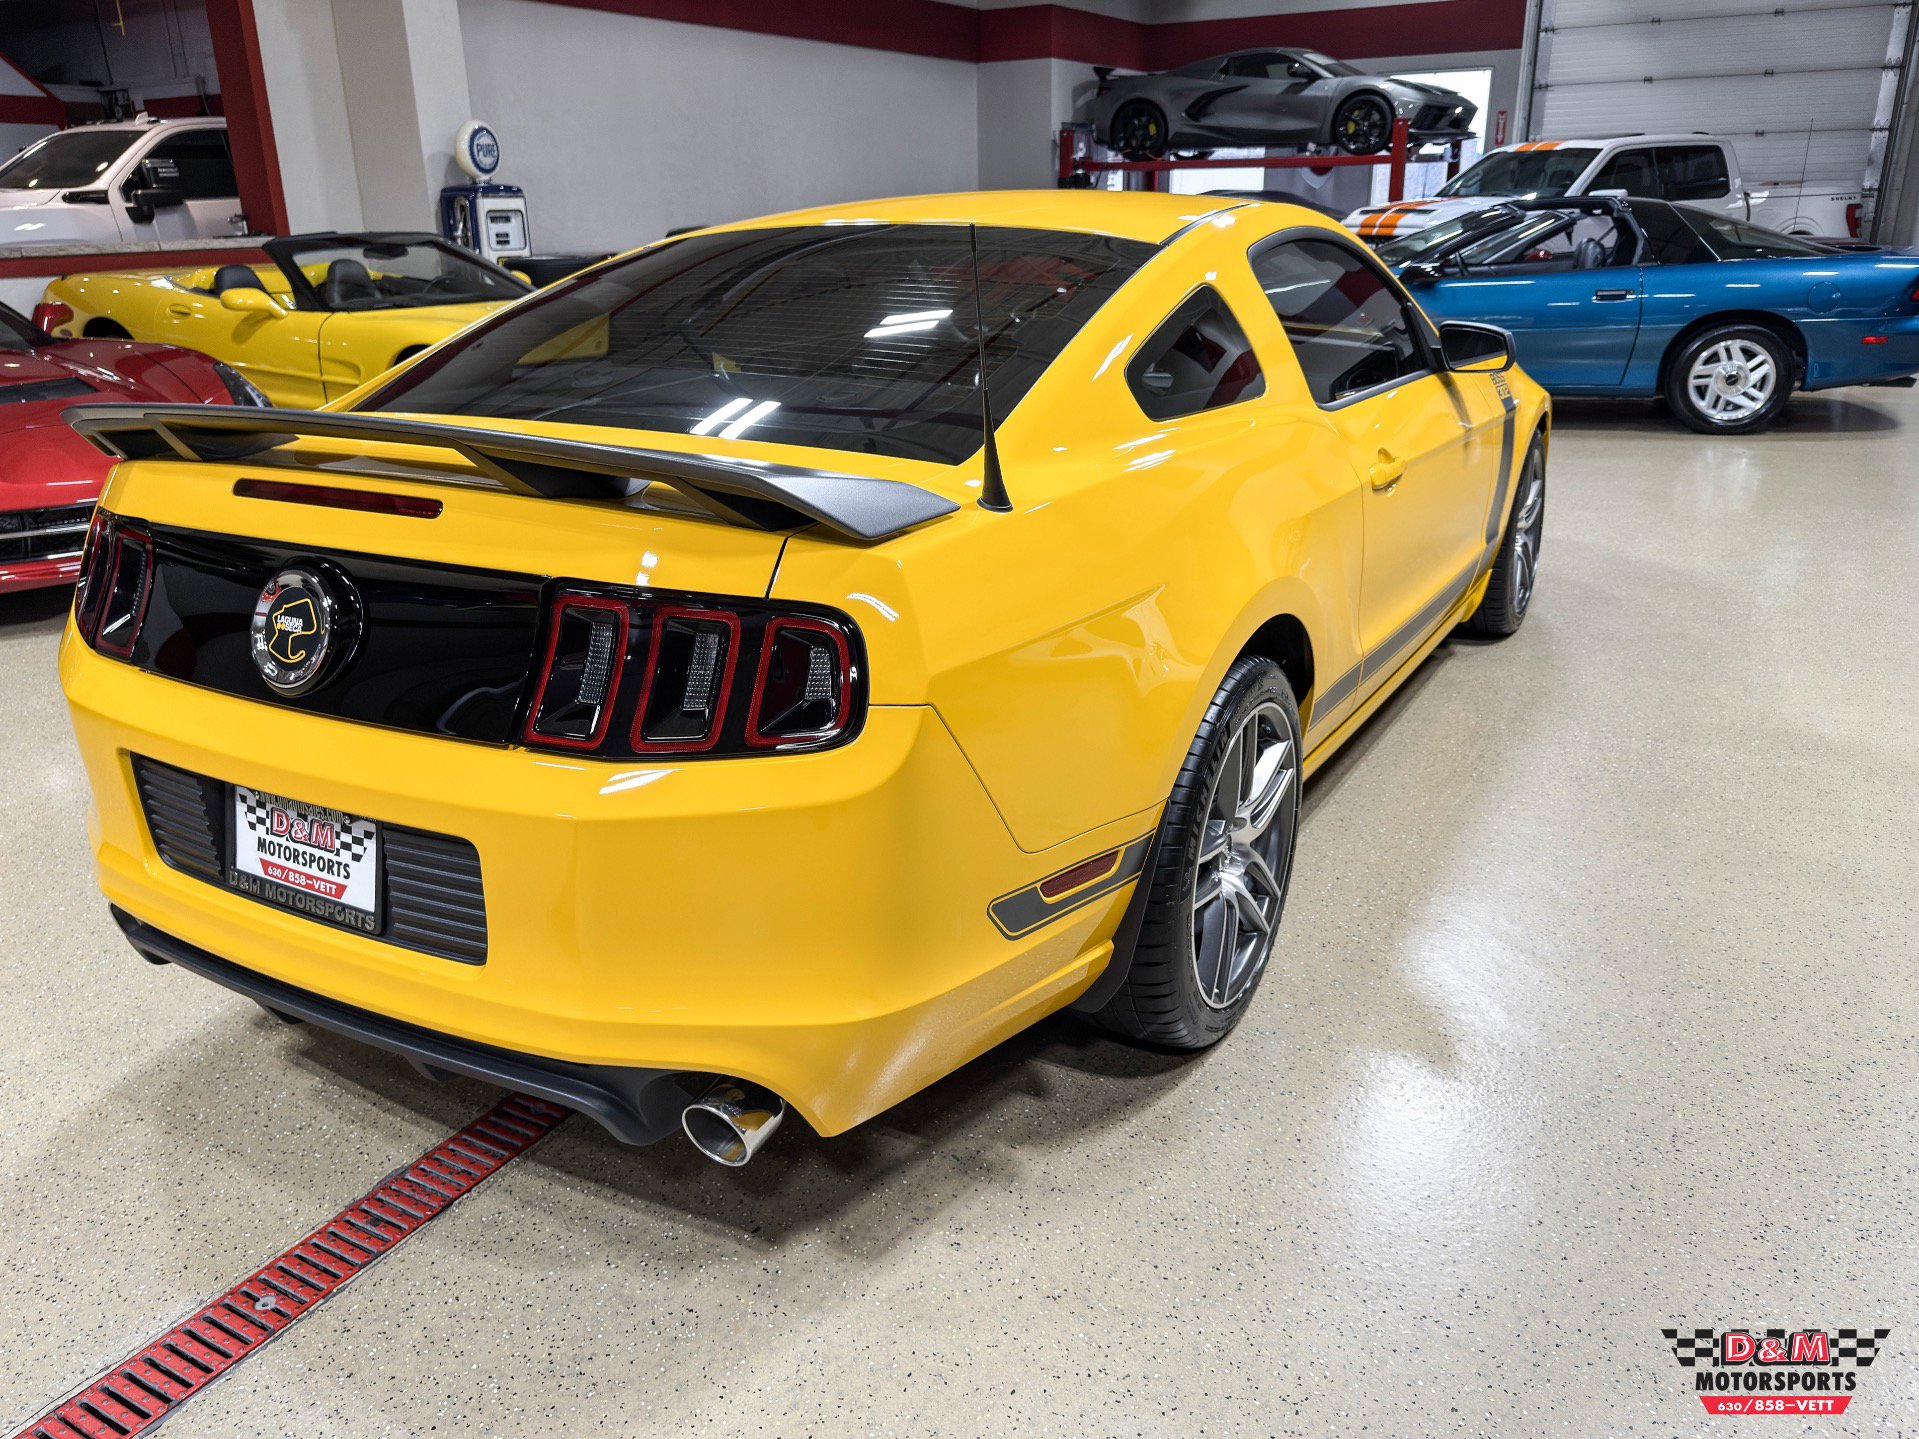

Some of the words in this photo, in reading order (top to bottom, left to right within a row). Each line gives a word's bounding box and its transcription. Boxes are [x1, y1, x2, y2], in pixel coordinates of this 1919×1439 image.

[476, 143, 496, 158] PURE
[277, 615, 303, 626] LAGUNA
[285, 622, 302, 633] SECA
[271, 807, 335, 852] D&M
[257, 837, 351, 880] MOTORSPORTS
[229, 871, 261, 895] D&M
[265, 884, 375, 931] MOTORSPORTS
